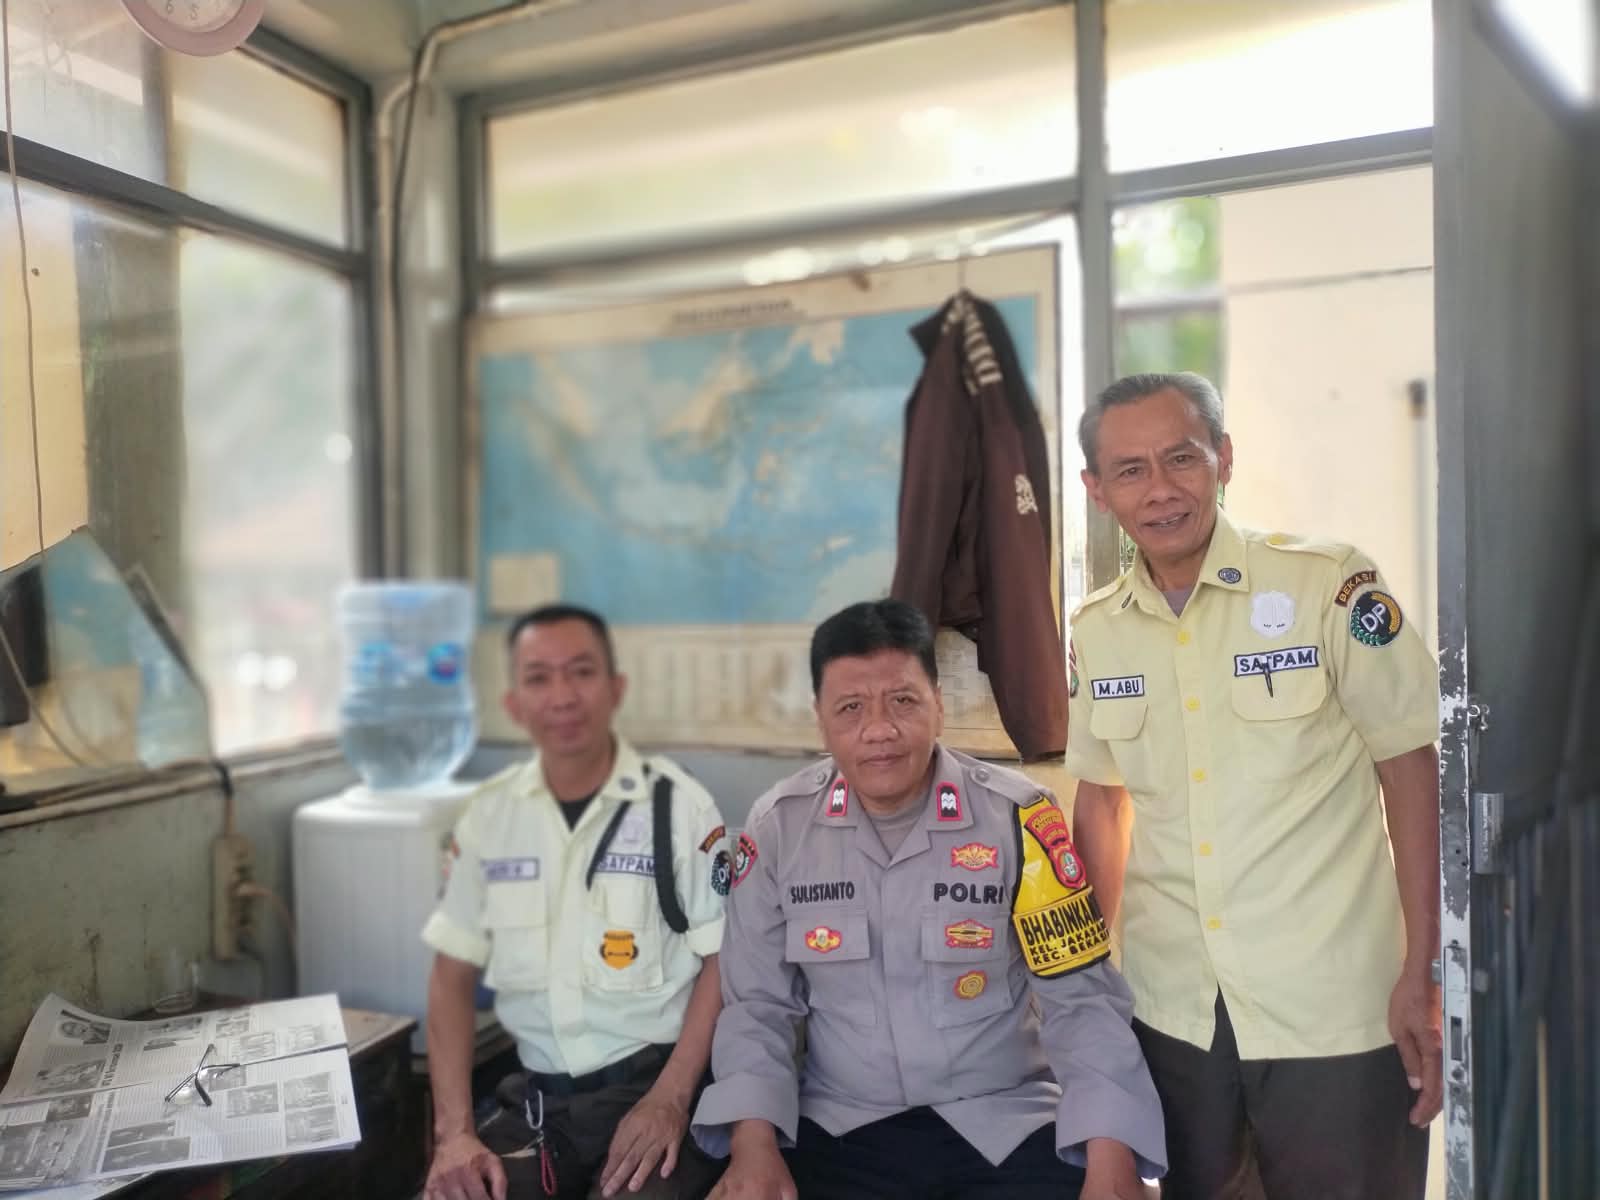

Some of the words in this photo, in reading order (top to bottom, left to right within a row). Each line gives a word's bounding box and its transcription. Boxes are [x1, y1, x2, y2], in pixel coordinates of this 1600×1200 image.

[1339, 573, 1373, 602] BEKASI
[1361, 603, 1387, 633] DP
[1240, 650, 1313, 672] SATPAM
[1098, 680, 1139, 695] M.ABU
[790, 881, 855, 904] SULISTANTO
[933, 882, 1004, 904] POLRI
[1033, 950, 1065, 966] KEC.
